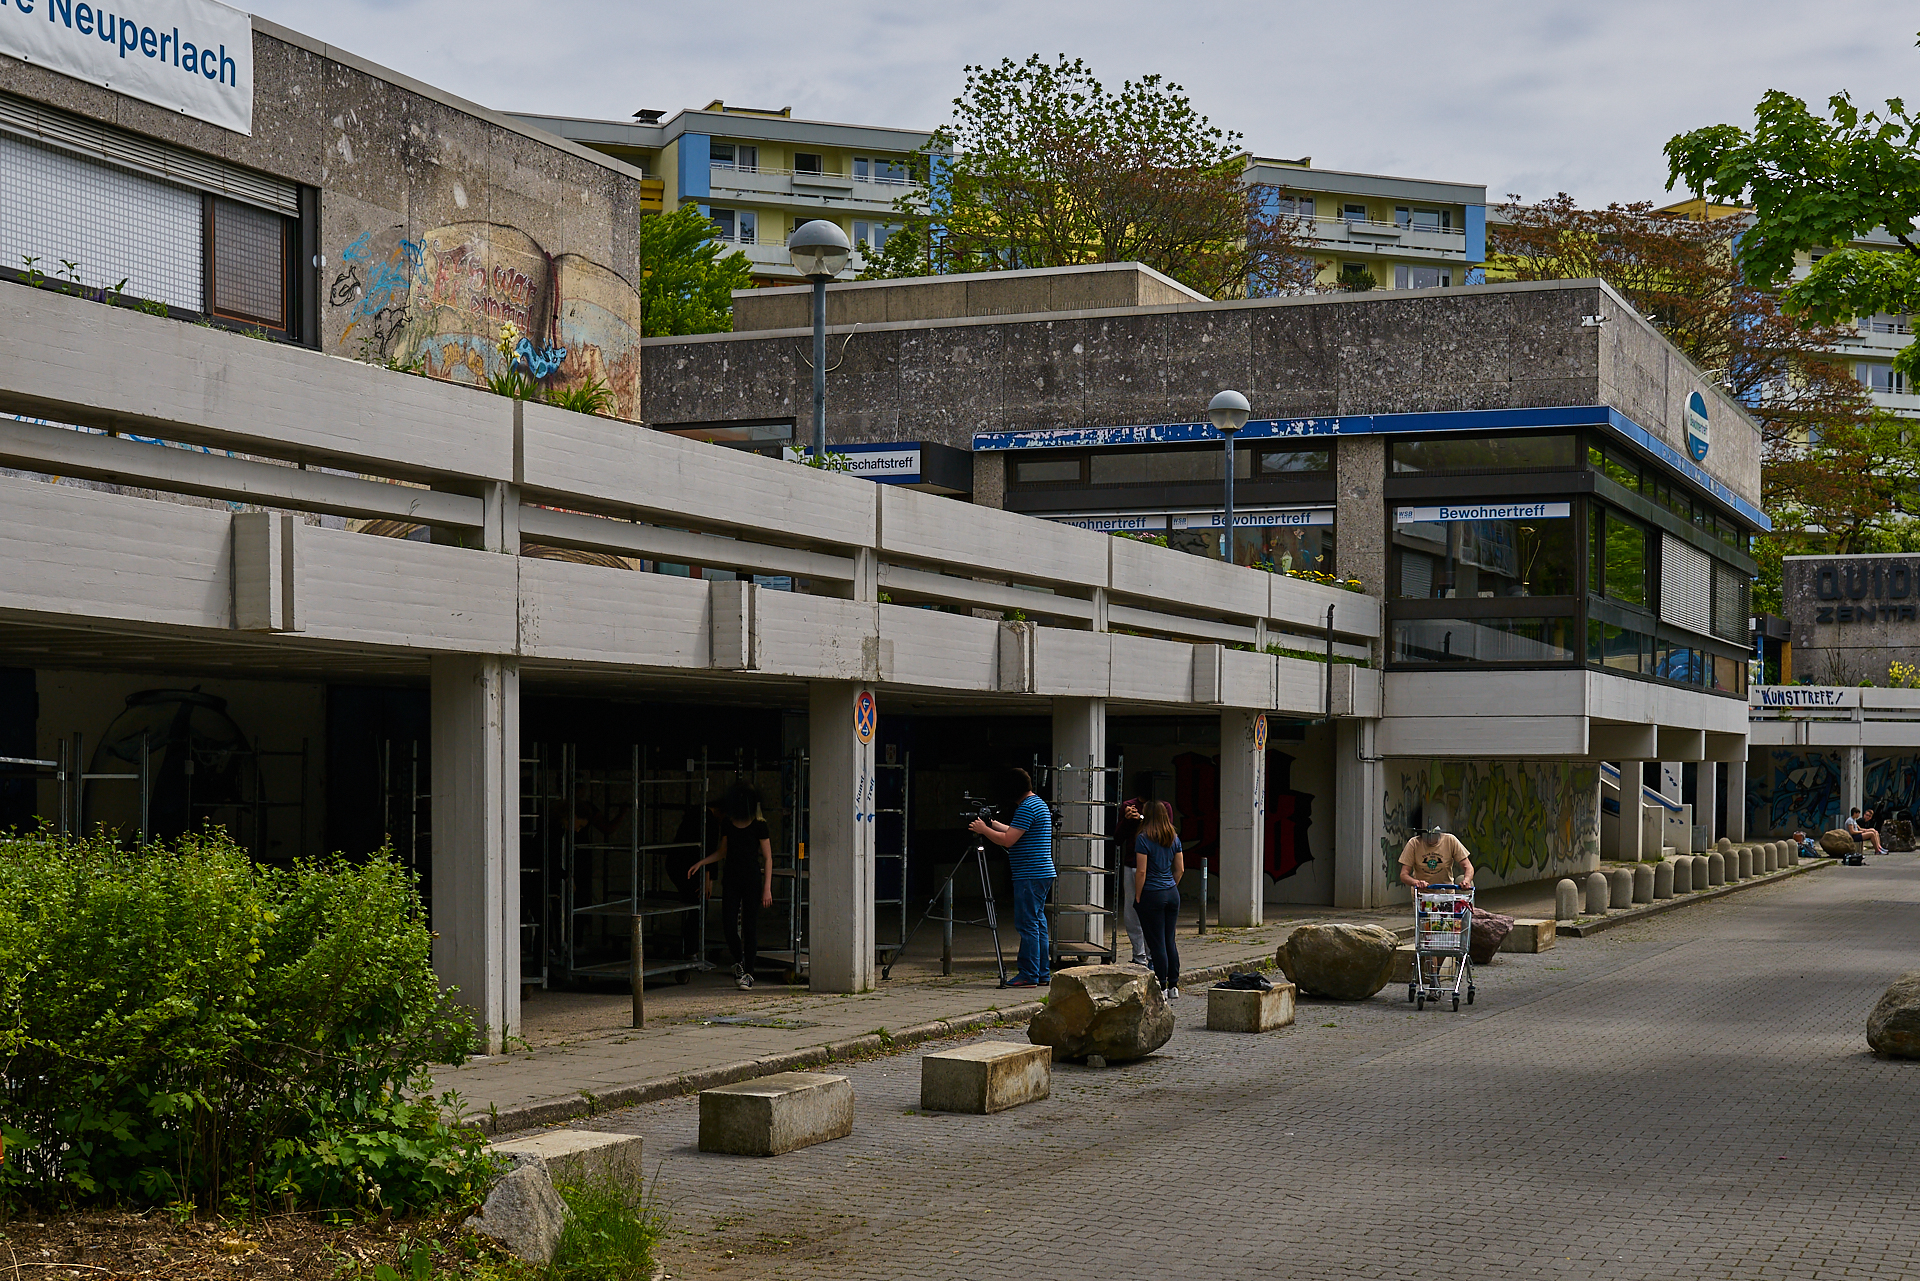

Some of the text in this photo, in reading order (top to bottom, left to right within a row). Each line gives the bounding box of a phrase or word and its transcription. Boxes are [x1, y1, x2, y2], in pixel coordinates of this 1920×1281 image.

[49, 0, 236, 88] Neuperlach
[493, 264, 537, 307] war
[470, 294, 535, 340] einmal
[1439, 504, 1545, 519] Bewohnertreff
[1816, 564, 1920, 600] QUID
